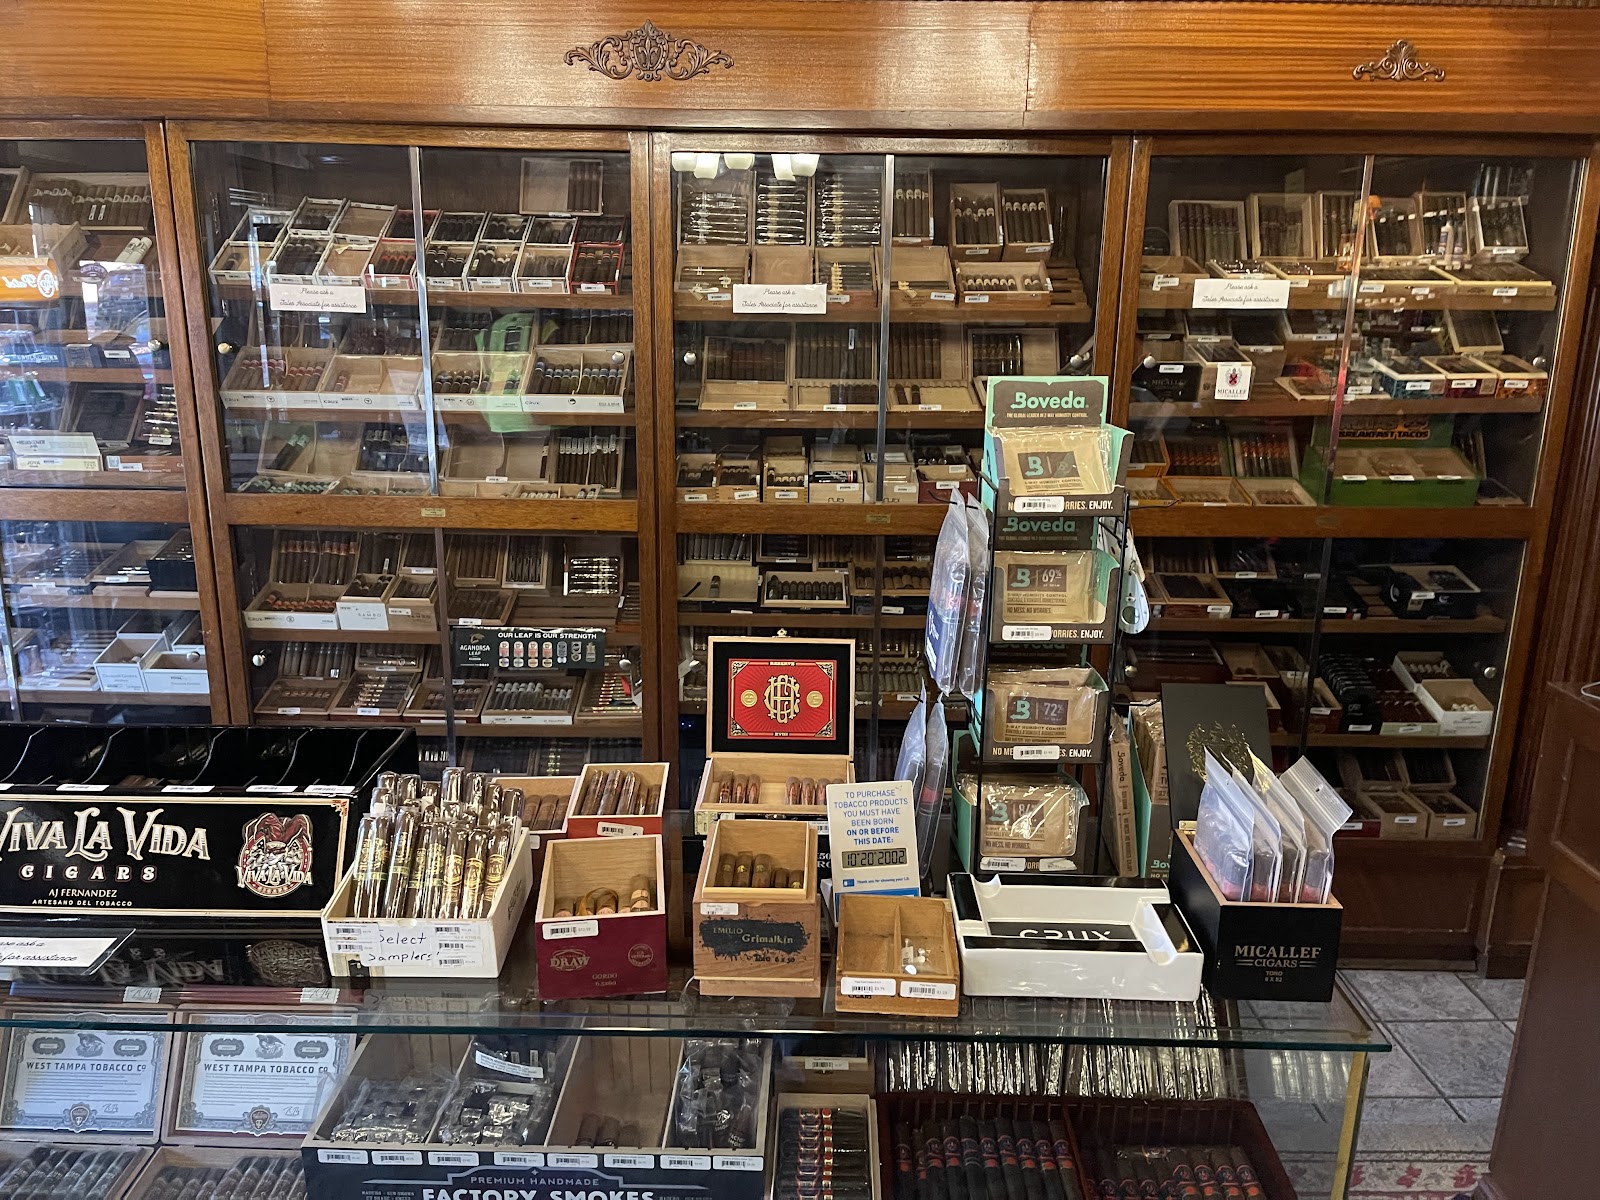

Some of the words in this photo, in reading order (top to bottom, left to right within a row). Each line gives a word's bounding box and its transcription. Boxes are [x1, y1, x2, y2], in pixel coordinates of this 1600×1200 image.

[319, 301, 330, 310] for
[1242, 296, 1252, 305] for
[781, 302, 791, 310] for
[1010, 390, 1086, 409] Boveda
[1339, 430, 1394, 438] BREAKFAST
[1397, 430, 1429, 438] TACOS
[1008, 502, 1014, 510] N
[1065, 501, 1088, 510] RRIES.
[1089, 500, 1114, 510] ENJOY.
[1002, 517, 1076, 532] Boveda
[1052, 630, 1079, 638] ORRIES.
[1080, 630, 1104, 638] ENJOY.
[992, 748, 1002, 756] NO
[1004, 748, 1014, 756] ME
[1069, 749, 1092, 758] ENJOY.
[1118, 752, 1126, 784] Boveda
[856, 790, 896, 798] PURCHASE
[870, 798, 908, 806] PRODUCTS
[860, 809, 880, 817] MUST
[882, 808, 900, 816] HAVE
[874, 818, 894, 826] BORN
[65, 806, 113, 862] LA
[116, 806, 210, 860] VIDA
[872, 836, 894, 844] DATE:
[1151, 860, 1170, 868] Bov
[19, 864, 157, 882] CIGARS
[234, 865, 266, 888] VIVA
[264, 865, 280, 886] LA
[280, 864, 314, 886] VIDA
[48, 888, 59, 897] AJ
[61, 888, 118, 898] FERNANDEZ
[379, 930, 426, 944] Select
[742, 934, 794, 944] Grimalkin
[1234, 946, 1322, 958] MICALLEF
[550, 956, 590, 968] DRAW
[1254, 959, 1298, 968] CIGARS
[26, 1062, 51, 1070] WEST
[55, 1062, 86, 1071] TAMPA
[90, 1064, 132, 1072] TOBACCO
[204, 1064, 230, 1072] WEST
[234, 1064, 266, 1073] TAMPA
[270, 1066, 314, 1074] TOBACCO
[470, 1176, 525, 1184] PREMIUM
[530, 1178, 600, 1186] HANDMADE
[422, 1188, 537, 1200] FACTORY
[550, 1190, 654, 1200] SMOKES
